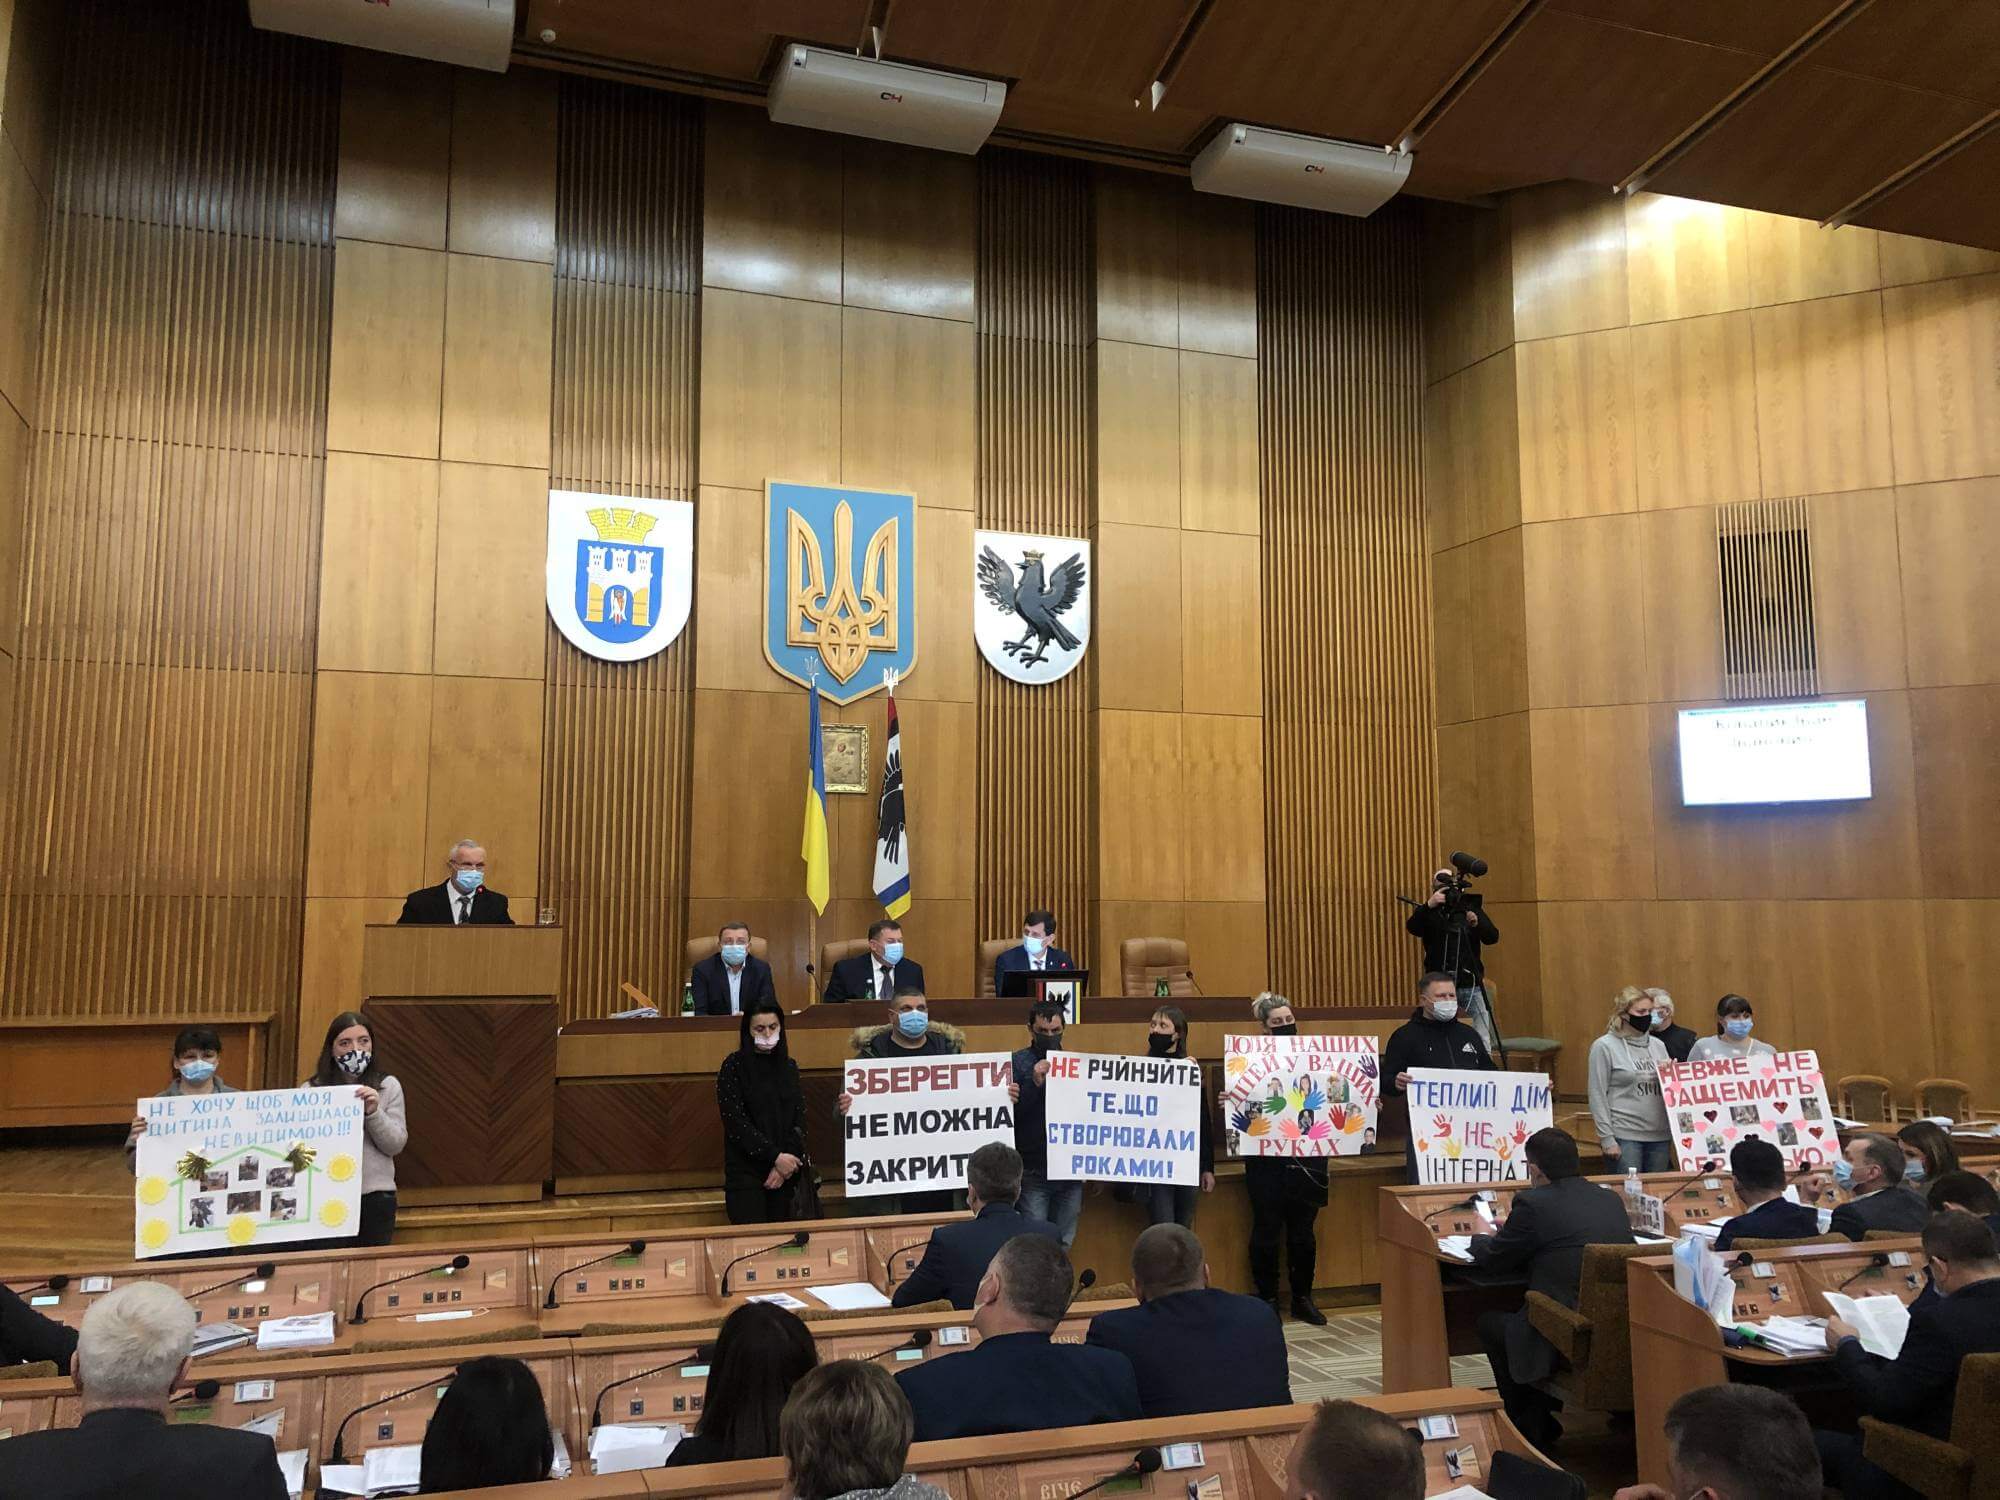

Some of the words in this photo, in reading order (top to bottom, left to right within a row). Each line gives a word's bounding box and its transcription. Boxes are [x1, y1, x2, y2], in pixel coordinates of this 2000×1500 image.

[1290, 1034, 1376, 1054] НАШИХ
[846, 1061, 1012, 1095] ЗБЕРЕГТИ
[1051, 1056, 1080, 1079] НЕ
[1088, 1056, 1200, 1087] РУЙНУЙТЕ
[1284, 1056, 1298, 1073] У
[1658, 1057, 1750, 1083] НЕВЖЕ
[1773, 1052, 1812, 1073] НЕ
[150, 1102, 175, 1117] НЕ
[191, 1097, 235, 1114] ХОЧУ
[246, 1095, 282, 1111] ЩОБ
[292, 1092, 332, 1106] МОЯ
[1511, 1083, 1549, 1114] ДІМ
[1664, 1076, 1815, 1107] ЗАЩЕМИТЬ
[147, 1115, 232, 1137] ДИТИНА
[256, 1105, 360, 1125] ЗАЛИШИЛАСЬ
[1465, 1121, 1494, 1149] НЕ
[1049, 1123, 1195, 1151] СТВОРЮВАЛИ
[1259, 1139, 1340, 1156] РУКАХ
[847, 1153, 969, 1186] ЗАКРИТ
[1072, 1155, 1173, 1178] РОКАМИ!
